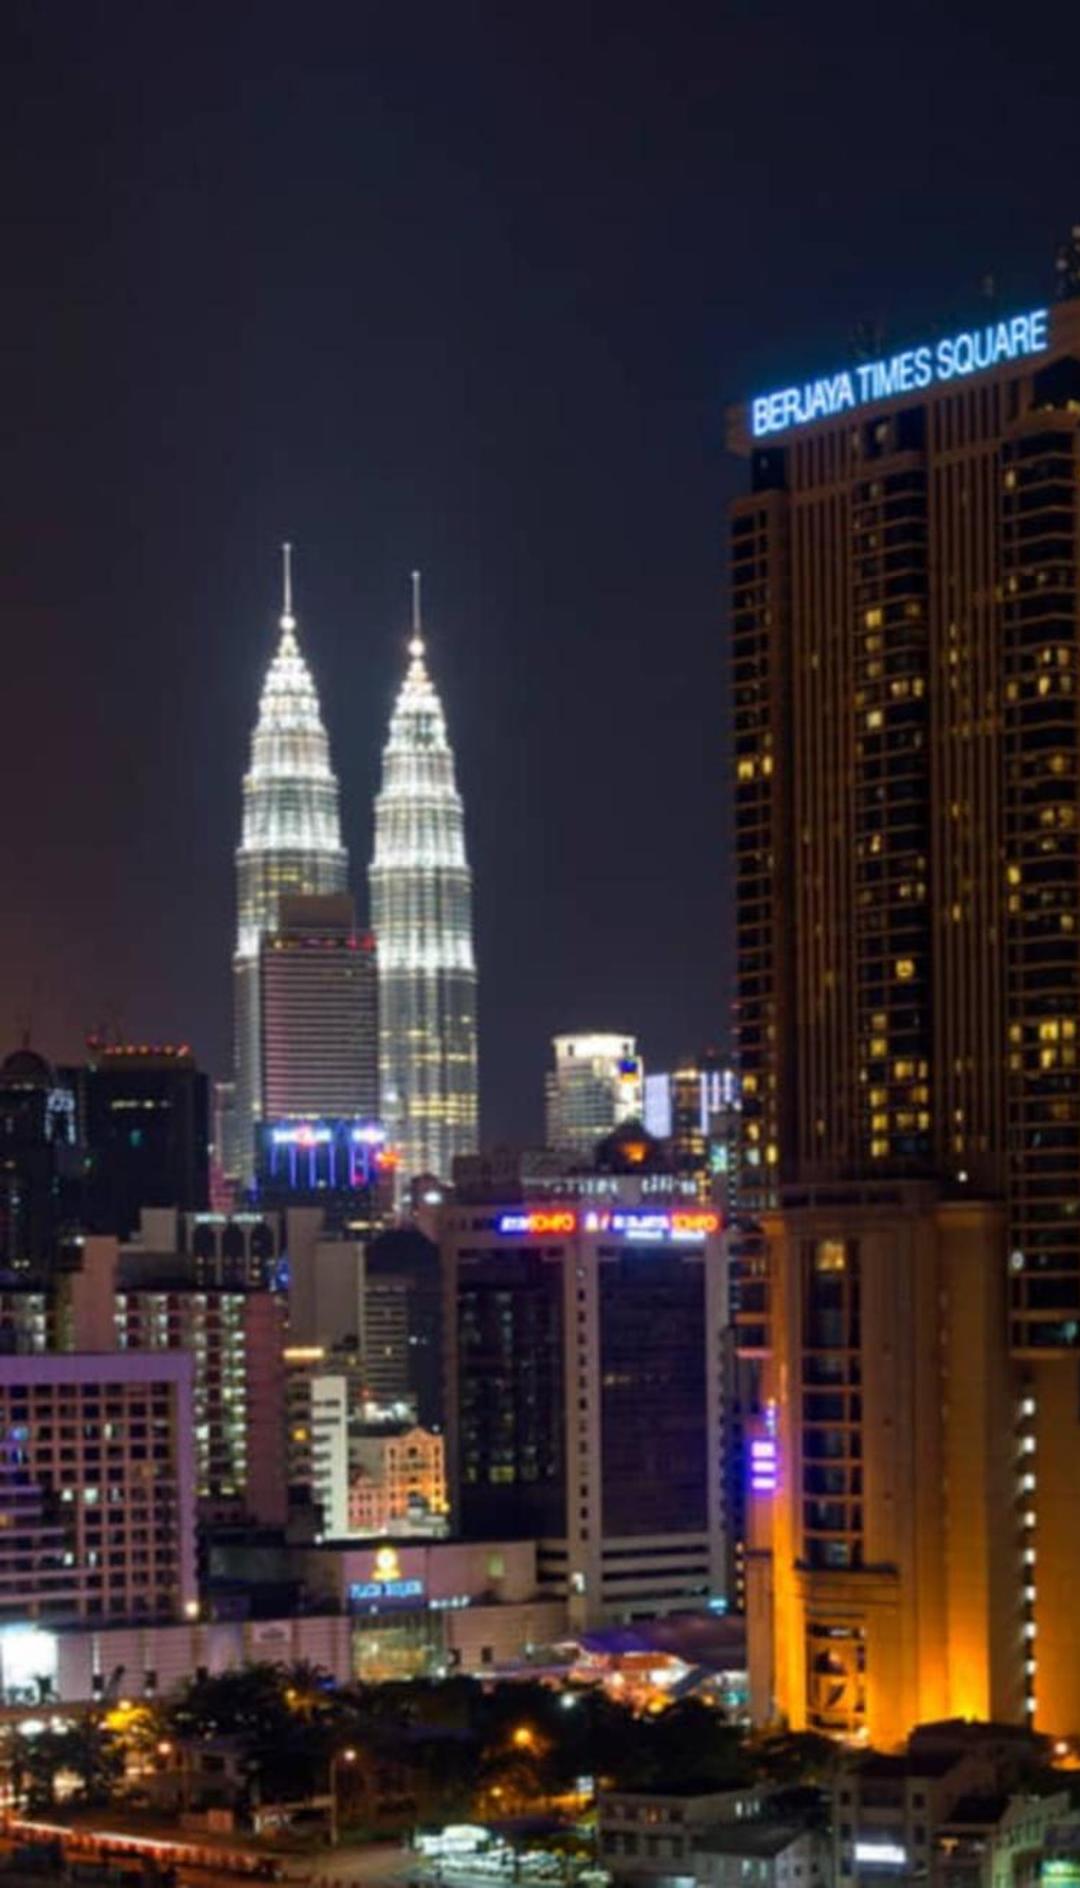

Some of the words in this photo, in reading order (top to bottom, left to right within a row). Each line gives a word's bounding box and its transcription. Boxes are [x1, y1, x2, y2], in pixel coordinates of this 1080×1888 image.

[752, 372, 855, 436] BERJAYA
[856, 347, 932, 401] TIMES
[937, 309, 1048, 380] SQUARE
